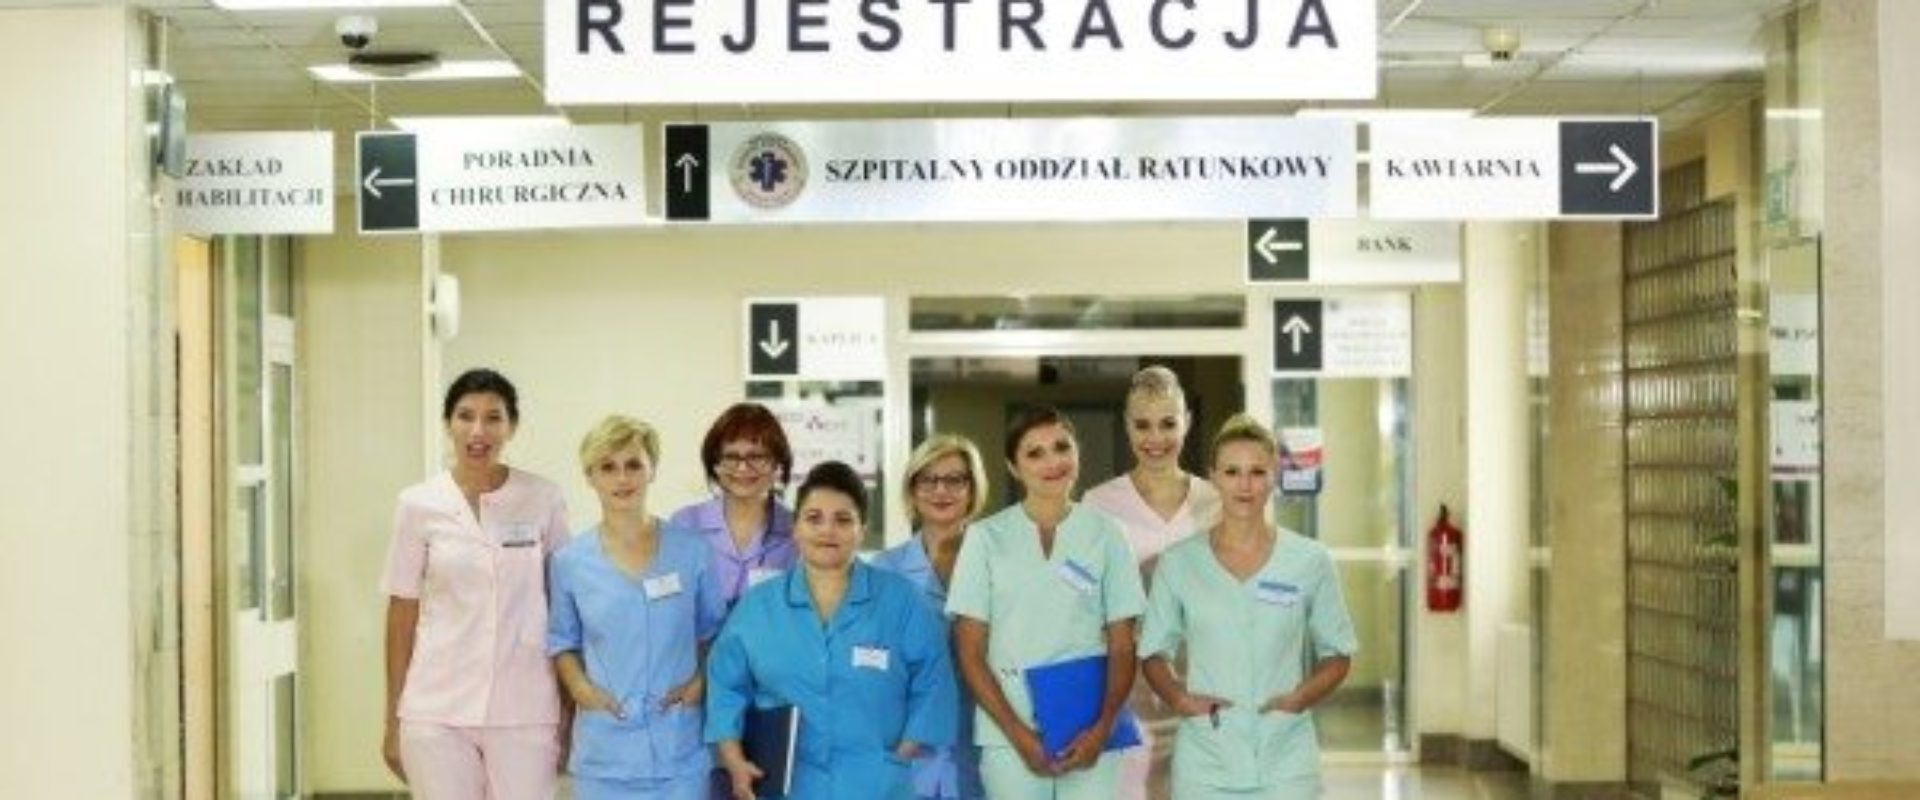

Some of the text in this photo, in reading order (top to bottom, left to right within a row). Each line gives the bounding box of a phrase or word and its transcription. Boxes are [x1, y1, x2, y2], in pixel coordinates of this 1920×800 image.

[576, 0, 1340, 55] REJESTRACJA
[463, 146, 595, 170] PORADNIA
[824, 154, 1331, 181] SZPITALNY ODDZIAŁ RATUNKOWY
[1386, 158, 1541, 178] KAWIARNIA
[430, 180, 628, 207] CHIRURGICZNA
